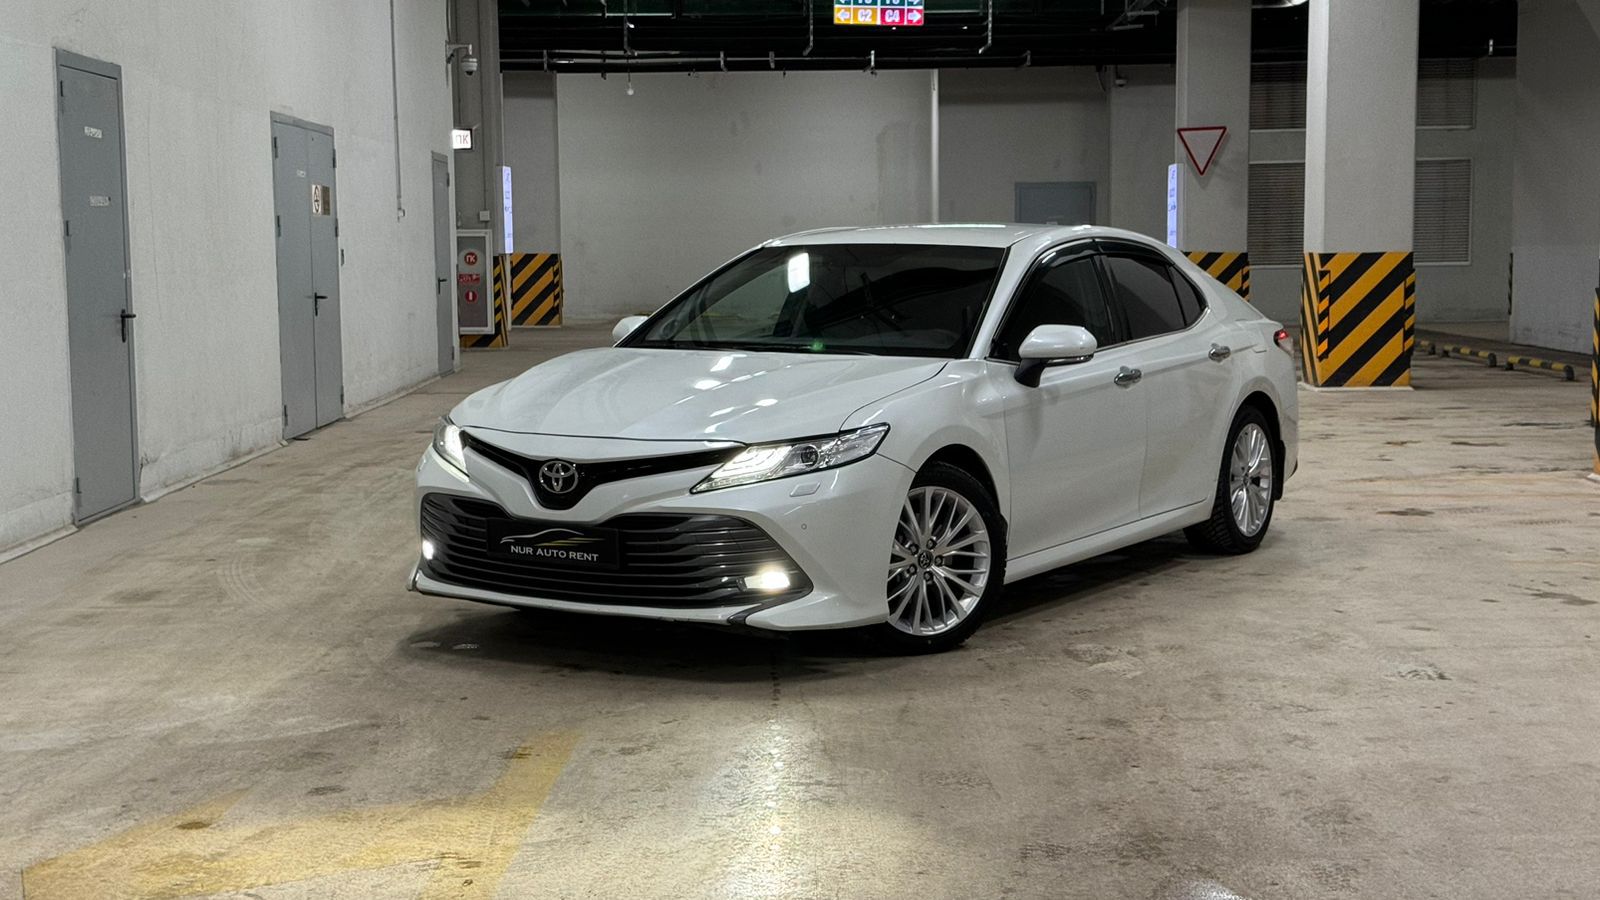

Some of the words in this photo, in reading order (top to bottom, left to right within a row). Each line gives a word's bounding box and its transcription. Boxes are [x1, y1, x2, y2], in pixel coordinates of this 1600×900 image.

[456, 134, 469, 145] ПК
[510, 545, 533, 555] NUR
[536, 548, 567, 558] AUTO
[569, 551, 599, 562] RENT
